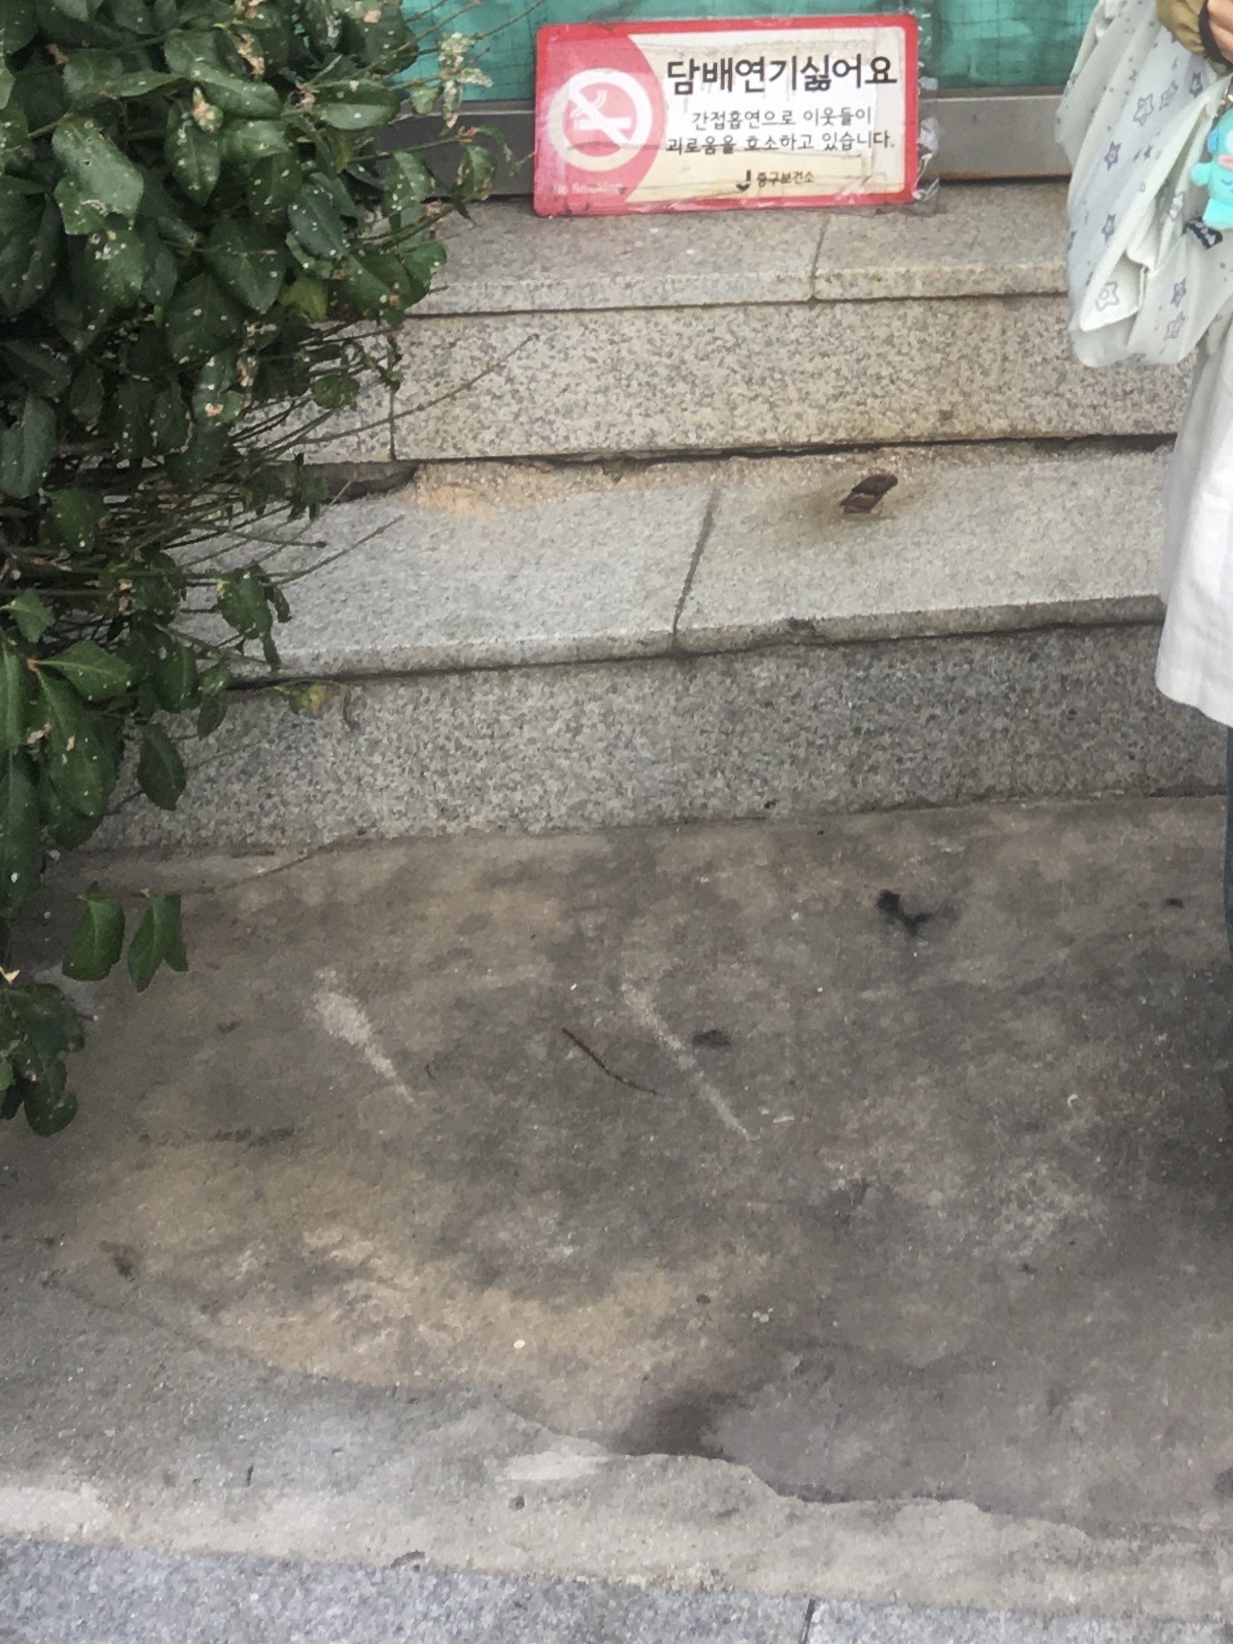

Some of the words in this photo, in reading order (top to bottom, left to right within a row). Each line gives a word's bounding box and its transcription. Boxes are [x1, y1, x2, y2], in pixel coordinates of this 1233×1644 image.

[667, 54, 897, 95] 담배연기싫어요
[692, 109, 796, 131] 간접흡연으로
[803, 106, 871, 126] 이웃들이
[666, 135, 737, 155] 괴로움을
[744, 133, 814, 151] 호소하고
[822, 130, 895, 151] 있습니다.
